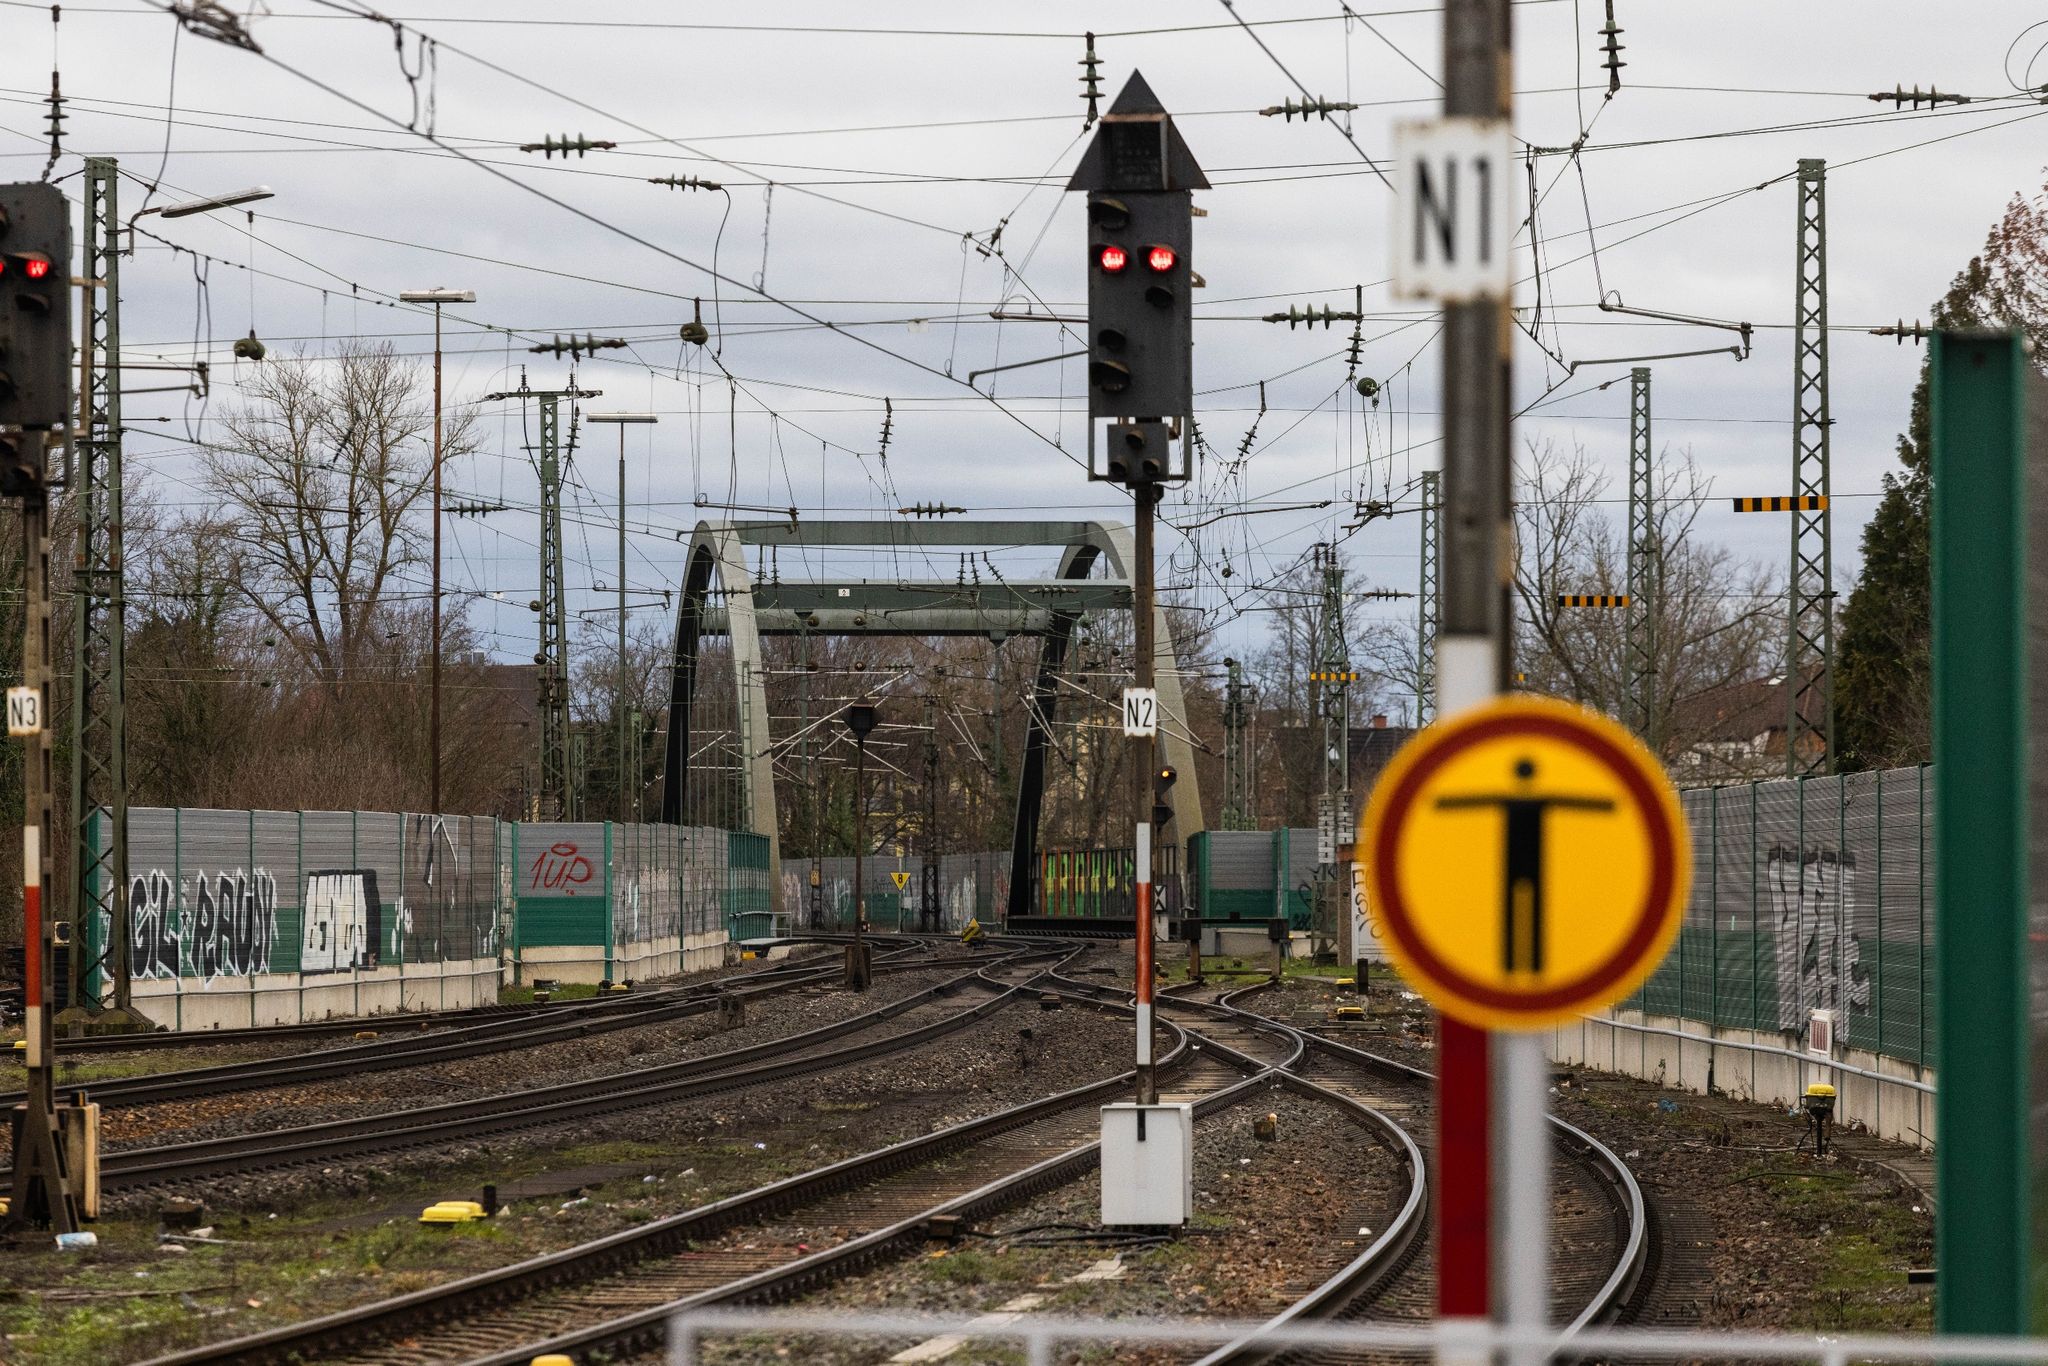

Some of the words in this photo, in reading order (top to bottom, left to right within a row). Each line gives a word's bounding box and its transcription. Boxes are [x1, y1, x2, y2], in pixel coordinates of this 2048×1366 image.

[1414, 155, 1491, 267] N1
[11, 697, 36, 727] N3
[1127, 697, 1152, 728] N2
[531, 851, 593, 890] 1UP
[897, 873, 904, 884] 8
